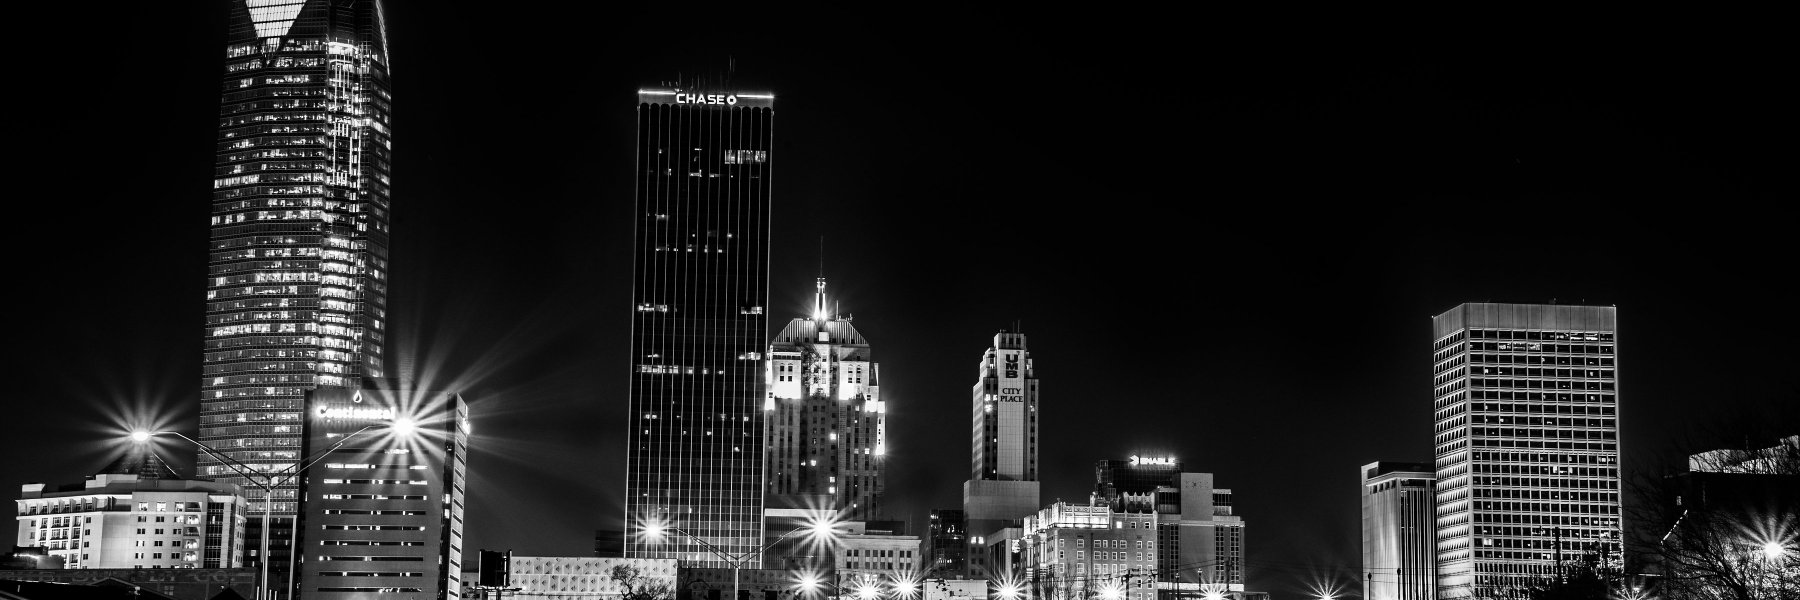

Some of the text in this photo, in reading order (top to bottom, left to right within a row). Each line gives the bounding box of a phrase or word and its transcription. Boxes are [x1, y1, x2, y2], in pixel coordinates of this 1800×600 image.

[676, 93, 725, 105] CHASE
[1005, 354, 1019, 379] UMB
[1002, 387, 1021, 395] CITY
[1000, 395, 1023, 403] PLACE
[316, 405, 396, 419] Continental
